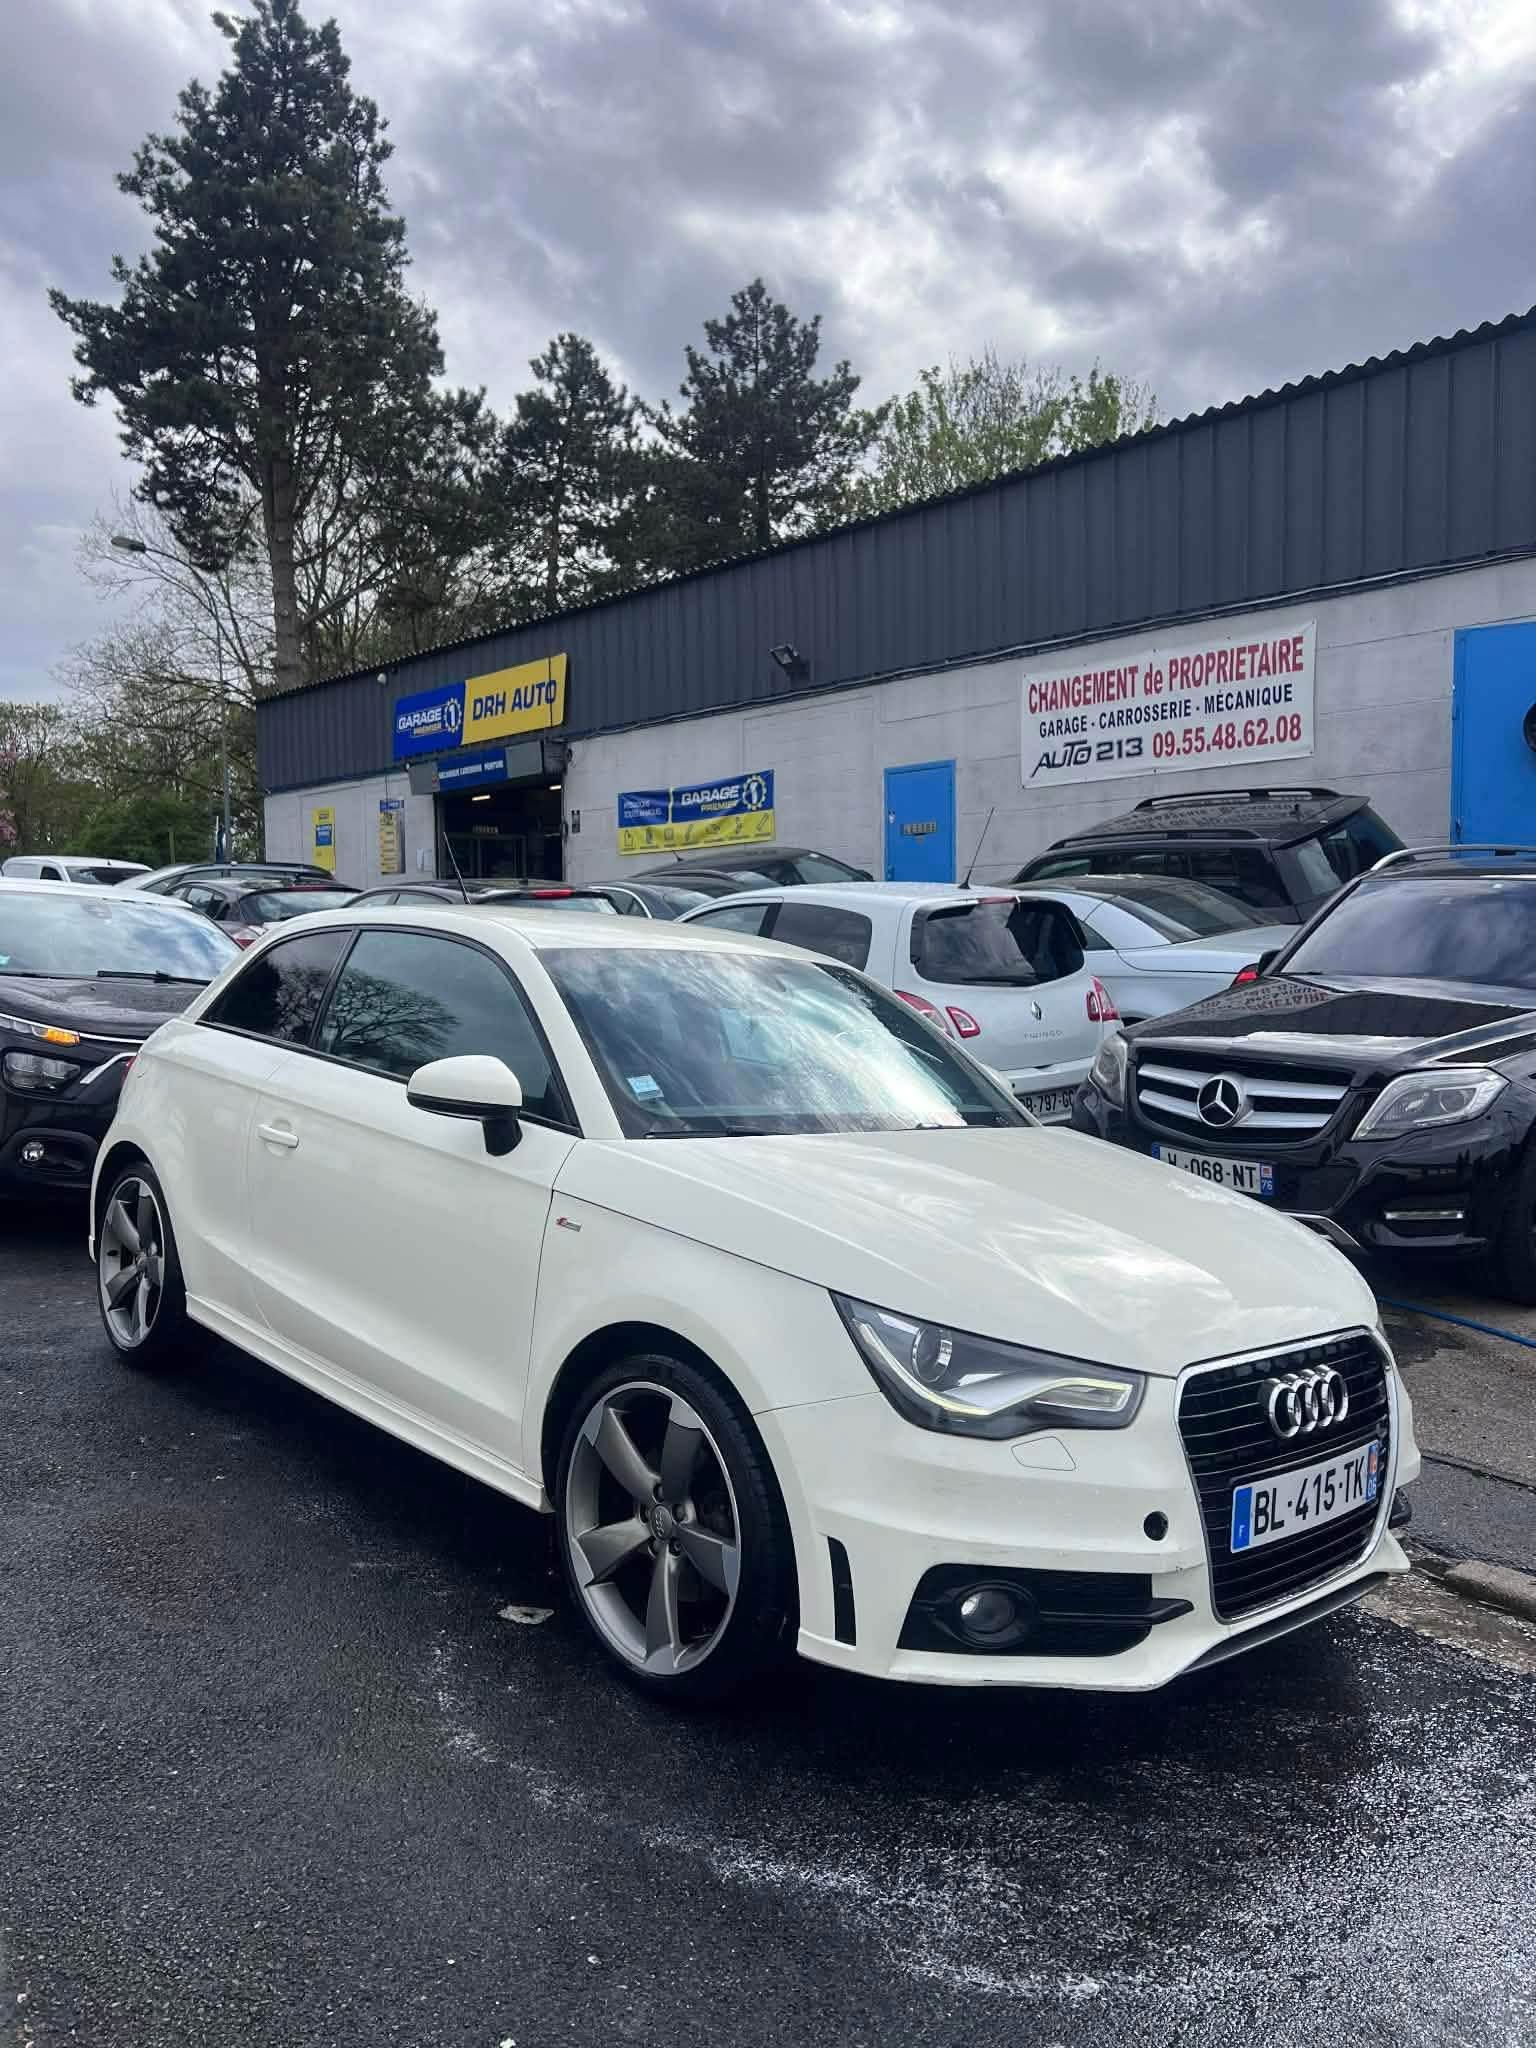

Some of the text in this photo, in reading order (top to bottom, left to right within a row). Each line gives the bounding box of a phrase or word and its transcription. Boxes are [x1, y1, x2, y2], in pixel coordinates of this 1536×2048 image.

[472, 679, 557, 721] DRH AUTO
[1028, 635, 1304, 715] CHANGEMENT de PROPRIETAIRE
[397, 709, 443, 731] GARAGE
[1039, 715, 1087, 739] GARAGE
[1099, 699, 1192, 730] CARROSSERIE
[1204, 683, 1293, 715] MÉCANIQUE
[1030, 713, 1302, 779] AUTO 213 09.55.48.62.08
[681, 785, 740, 806] GARAGE
[1254, 1455, 1365, 1537] BL-415-TK
